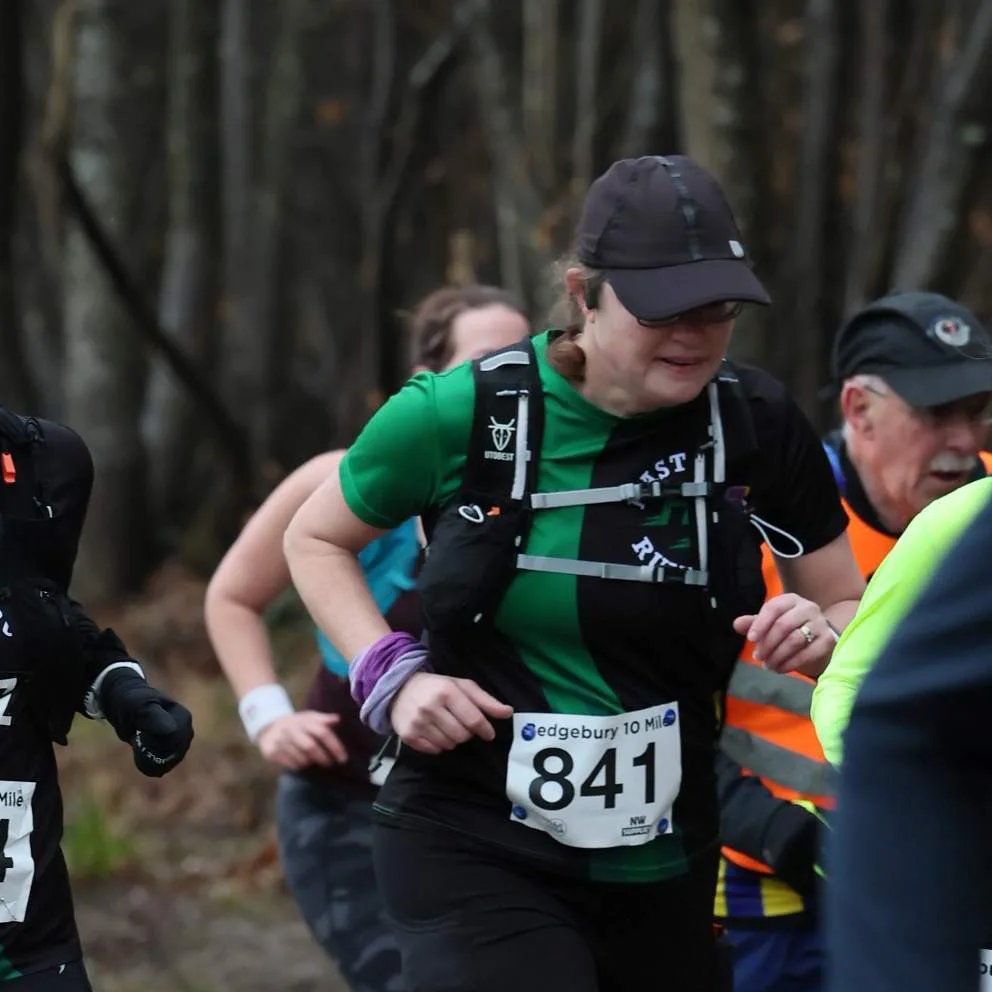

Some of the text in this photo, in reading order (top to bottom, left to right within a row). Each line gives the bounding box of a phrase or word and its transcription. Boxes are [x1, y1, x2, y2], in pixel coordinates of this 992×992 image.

[526, 716, 670, 741] edgebury 10 Mil
[528, 741, 656, 811] 841
[630, 816, 646, 825] NW
